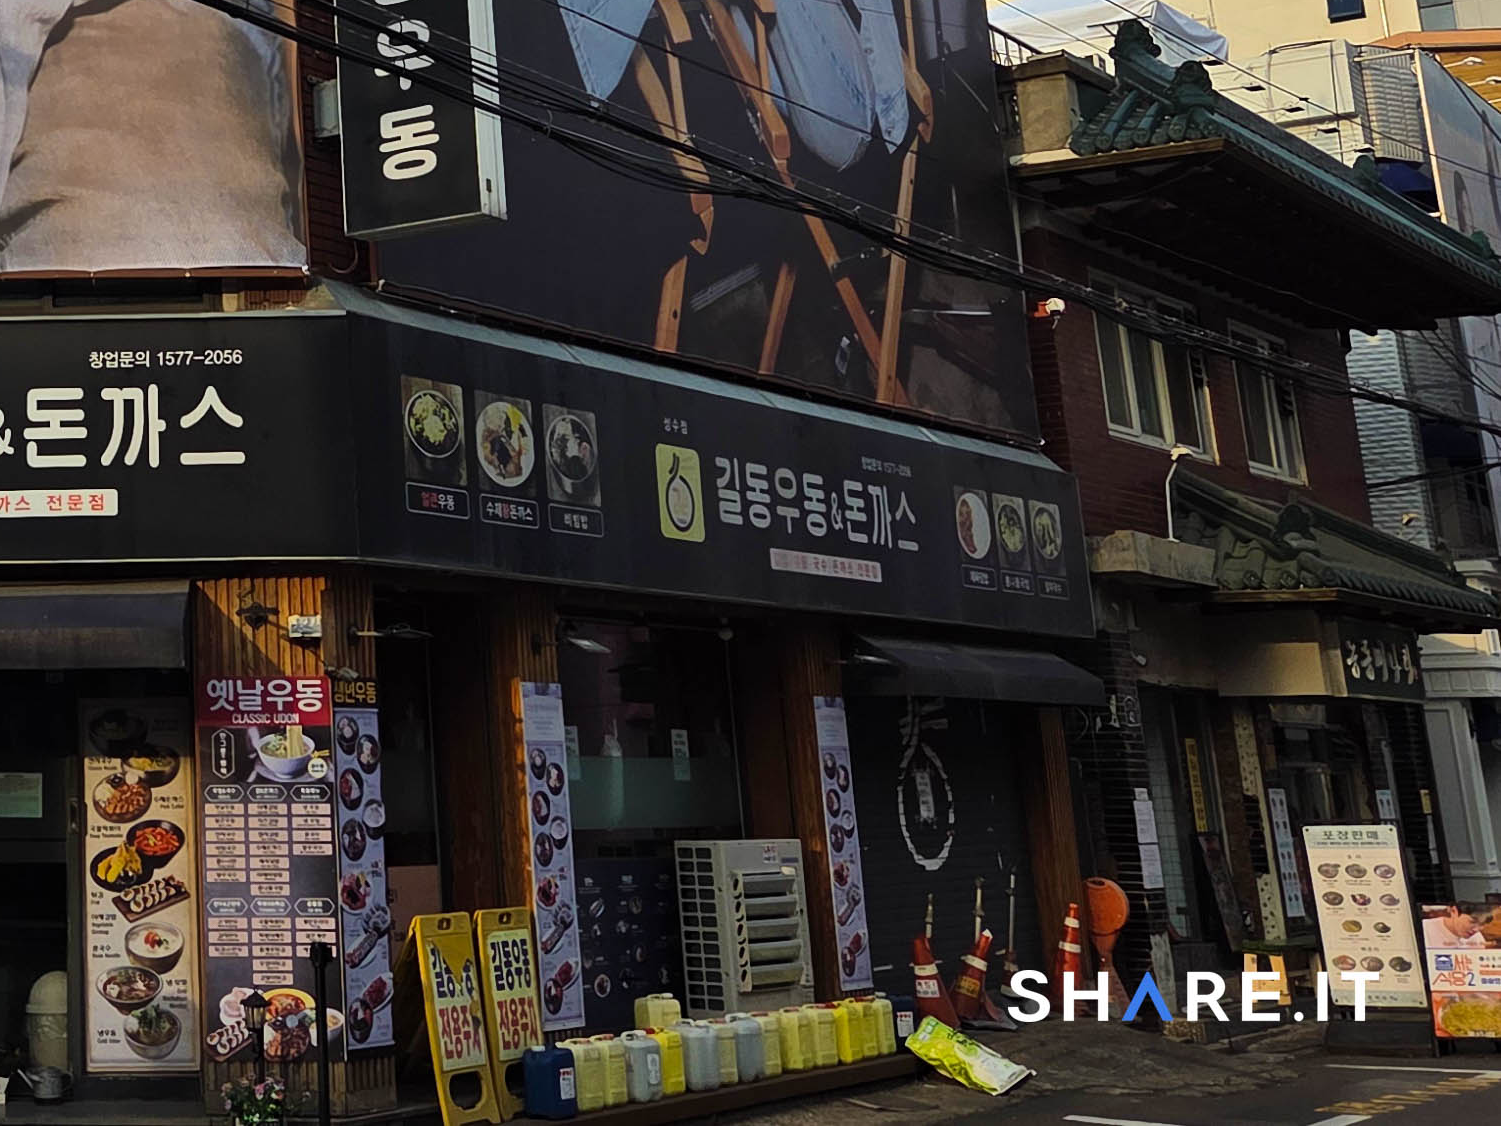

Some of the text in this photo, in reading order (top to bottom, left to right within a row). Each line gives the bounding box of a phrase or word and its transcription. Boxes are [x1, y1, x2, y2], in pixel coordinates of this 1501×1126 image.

[89, 349, 243, 368] 창업문의 1577-2056
[46, 493, 106, 512] 전문점
[206, 679, 324, 713] 옛날우동
[232, 712, 272, 724] CLASSIC
